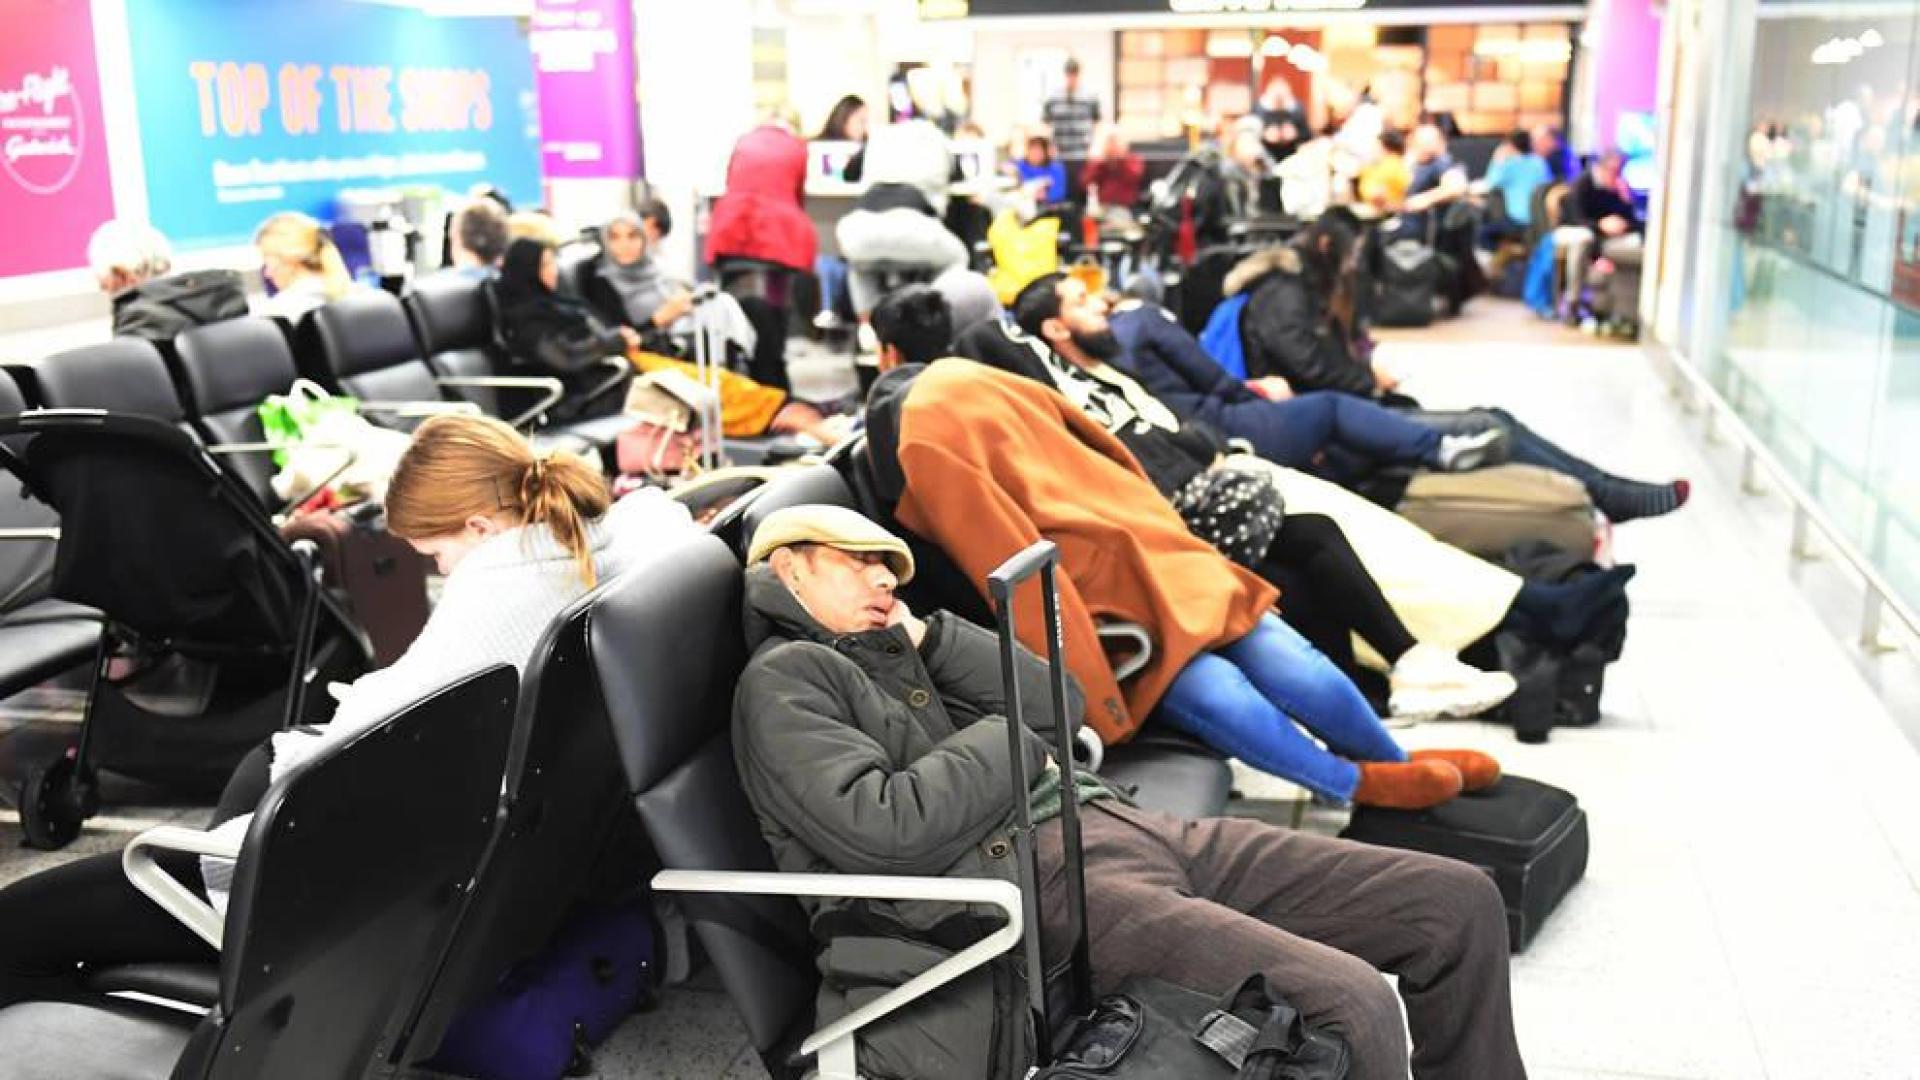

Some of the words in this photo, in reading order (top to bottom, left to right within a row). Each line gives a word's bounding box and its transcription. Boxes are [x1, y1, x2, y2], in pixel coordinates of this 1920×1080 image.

[190, 62, 269, 136] TOP
[278, 62, 322, 135] OF
[330, 65, 395, 133] THE
